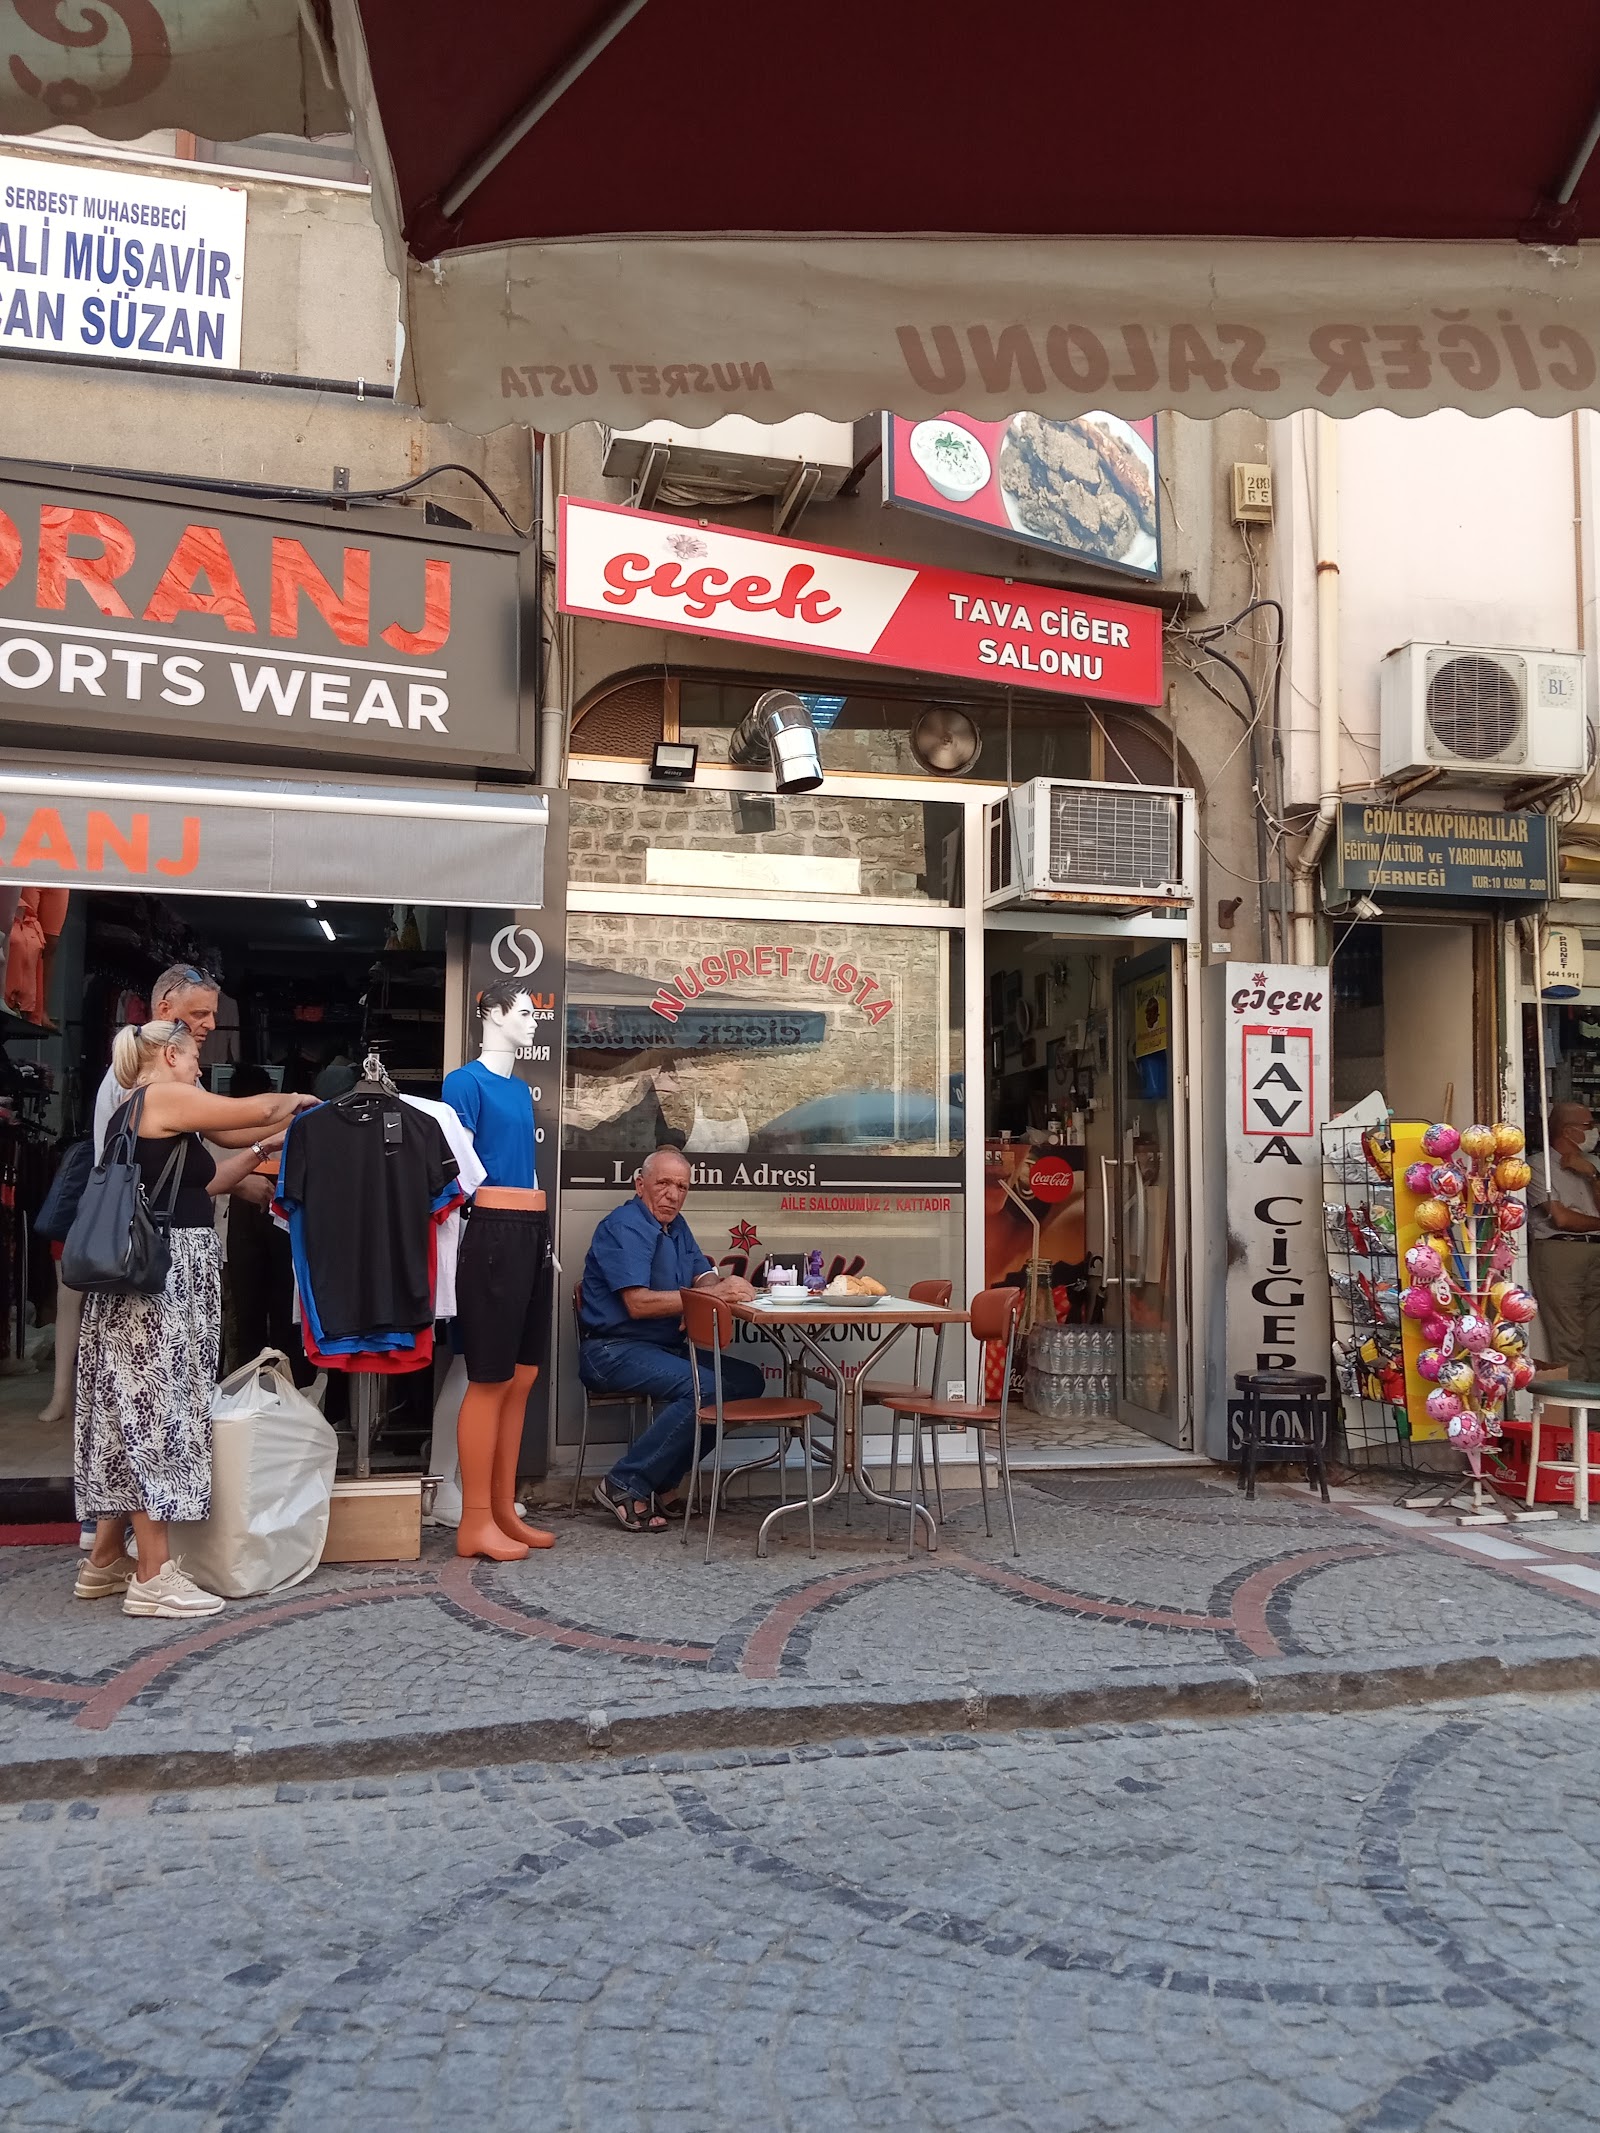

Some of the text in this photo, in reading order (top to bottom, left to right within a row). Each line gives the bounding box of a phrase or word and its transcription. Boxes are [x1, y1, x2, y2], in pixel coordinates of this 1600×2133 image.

[5, 186, 186, 231] SERBEST MUHASEBECİ
[63, 225, 231, 300] MÜŞAVİR
[80, 291, 225, 360] SÜZAN
[0, 504, 451, 656] RANJ
[948, 593, 1131, 649] TAVA CİĞER
[978, 638, 1104, 681] SALONU
[229, 661, 450, 733] WEAR
[0, 807, 200, 877] ANJ
[1363, 806, 1529, 843] ÇÖMLEKAKPINARLILAR
[1344, 839, 1524, 869] EĞİTİM KÜLTÜR VE YARDIMLAŞMA
[1368, 868, 1446, 887] DERNEĞİ
[1559, 936, 1568, 969] PRONET
[650, 945, 894, 1026] NUSRET USTA
[531, 1011, 554, 1020] EAR
[731, 1162, 817, 1187] Adresi
[780, 1194, 951, 1212] AİLE SALONUMUZ 2 KATTADIR
